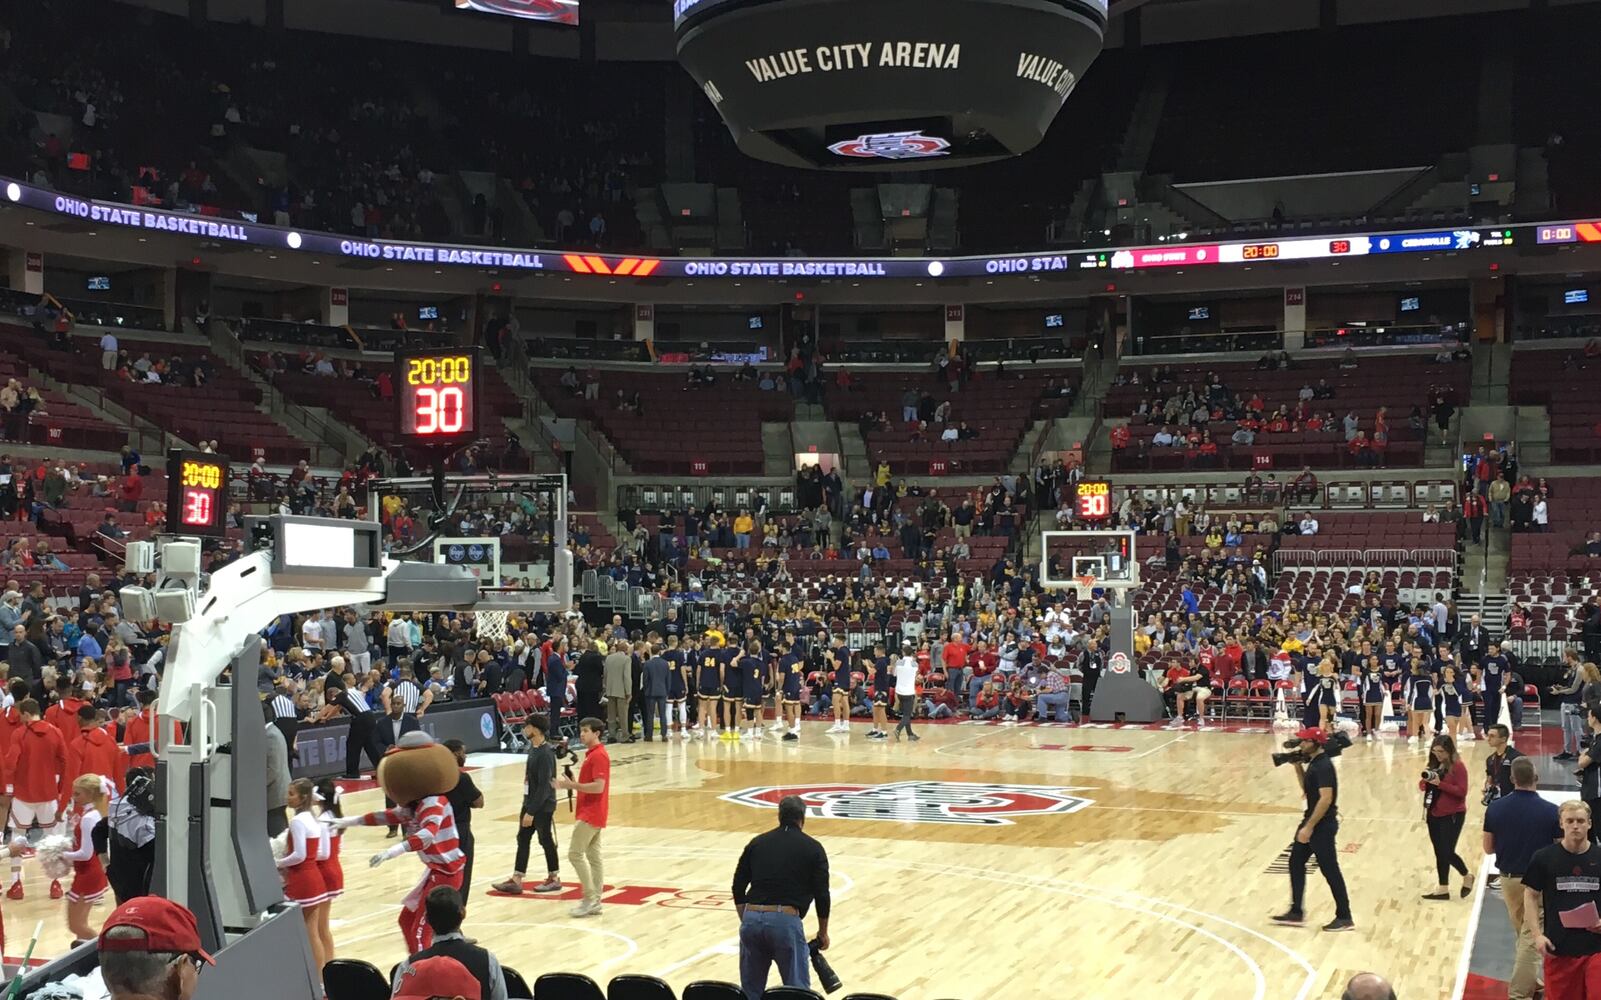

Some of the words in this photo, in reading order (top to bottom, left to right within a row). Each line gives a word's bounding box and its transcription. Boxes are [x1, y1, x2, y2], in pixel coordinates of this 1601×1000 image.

[745, 48, 813, 82] VALUE
[816, 42, 872, 71] CITY
[879, 42, 961, 69] ARENA
[1016, 52, 1063, 87] VALUE
[55, 197, 89, 217] OHIO
[90, 206, 141, 226] STATE
[144, 213, 248, 241] BASKETBALL
[340, 240, 380, 258] OHIO
[383, 245, 434, 262] STATE
[437, 249, 543, 268] BASKETBALL
[1243, 245, 1277, 258] 20:00
[1333, 242, 1347, 252] 30
[684, 262, 727, 275] OHIO
[730, 262, 779, 275] STATE
[782, 262, 885, 275] BASKETBALL
[986, 259, 1028, 273] OHIO
[407, 357, 469, 385] 20:00
[416, 387, 463, 433] 30
[1256, 456, 1270, 464] 114
[1077, 483, 1108, 495] 20:00
[186, 491, 210, 524] 30
[1081, 495, 1105, 515] 30
[704, 656, 716, 667] 24
